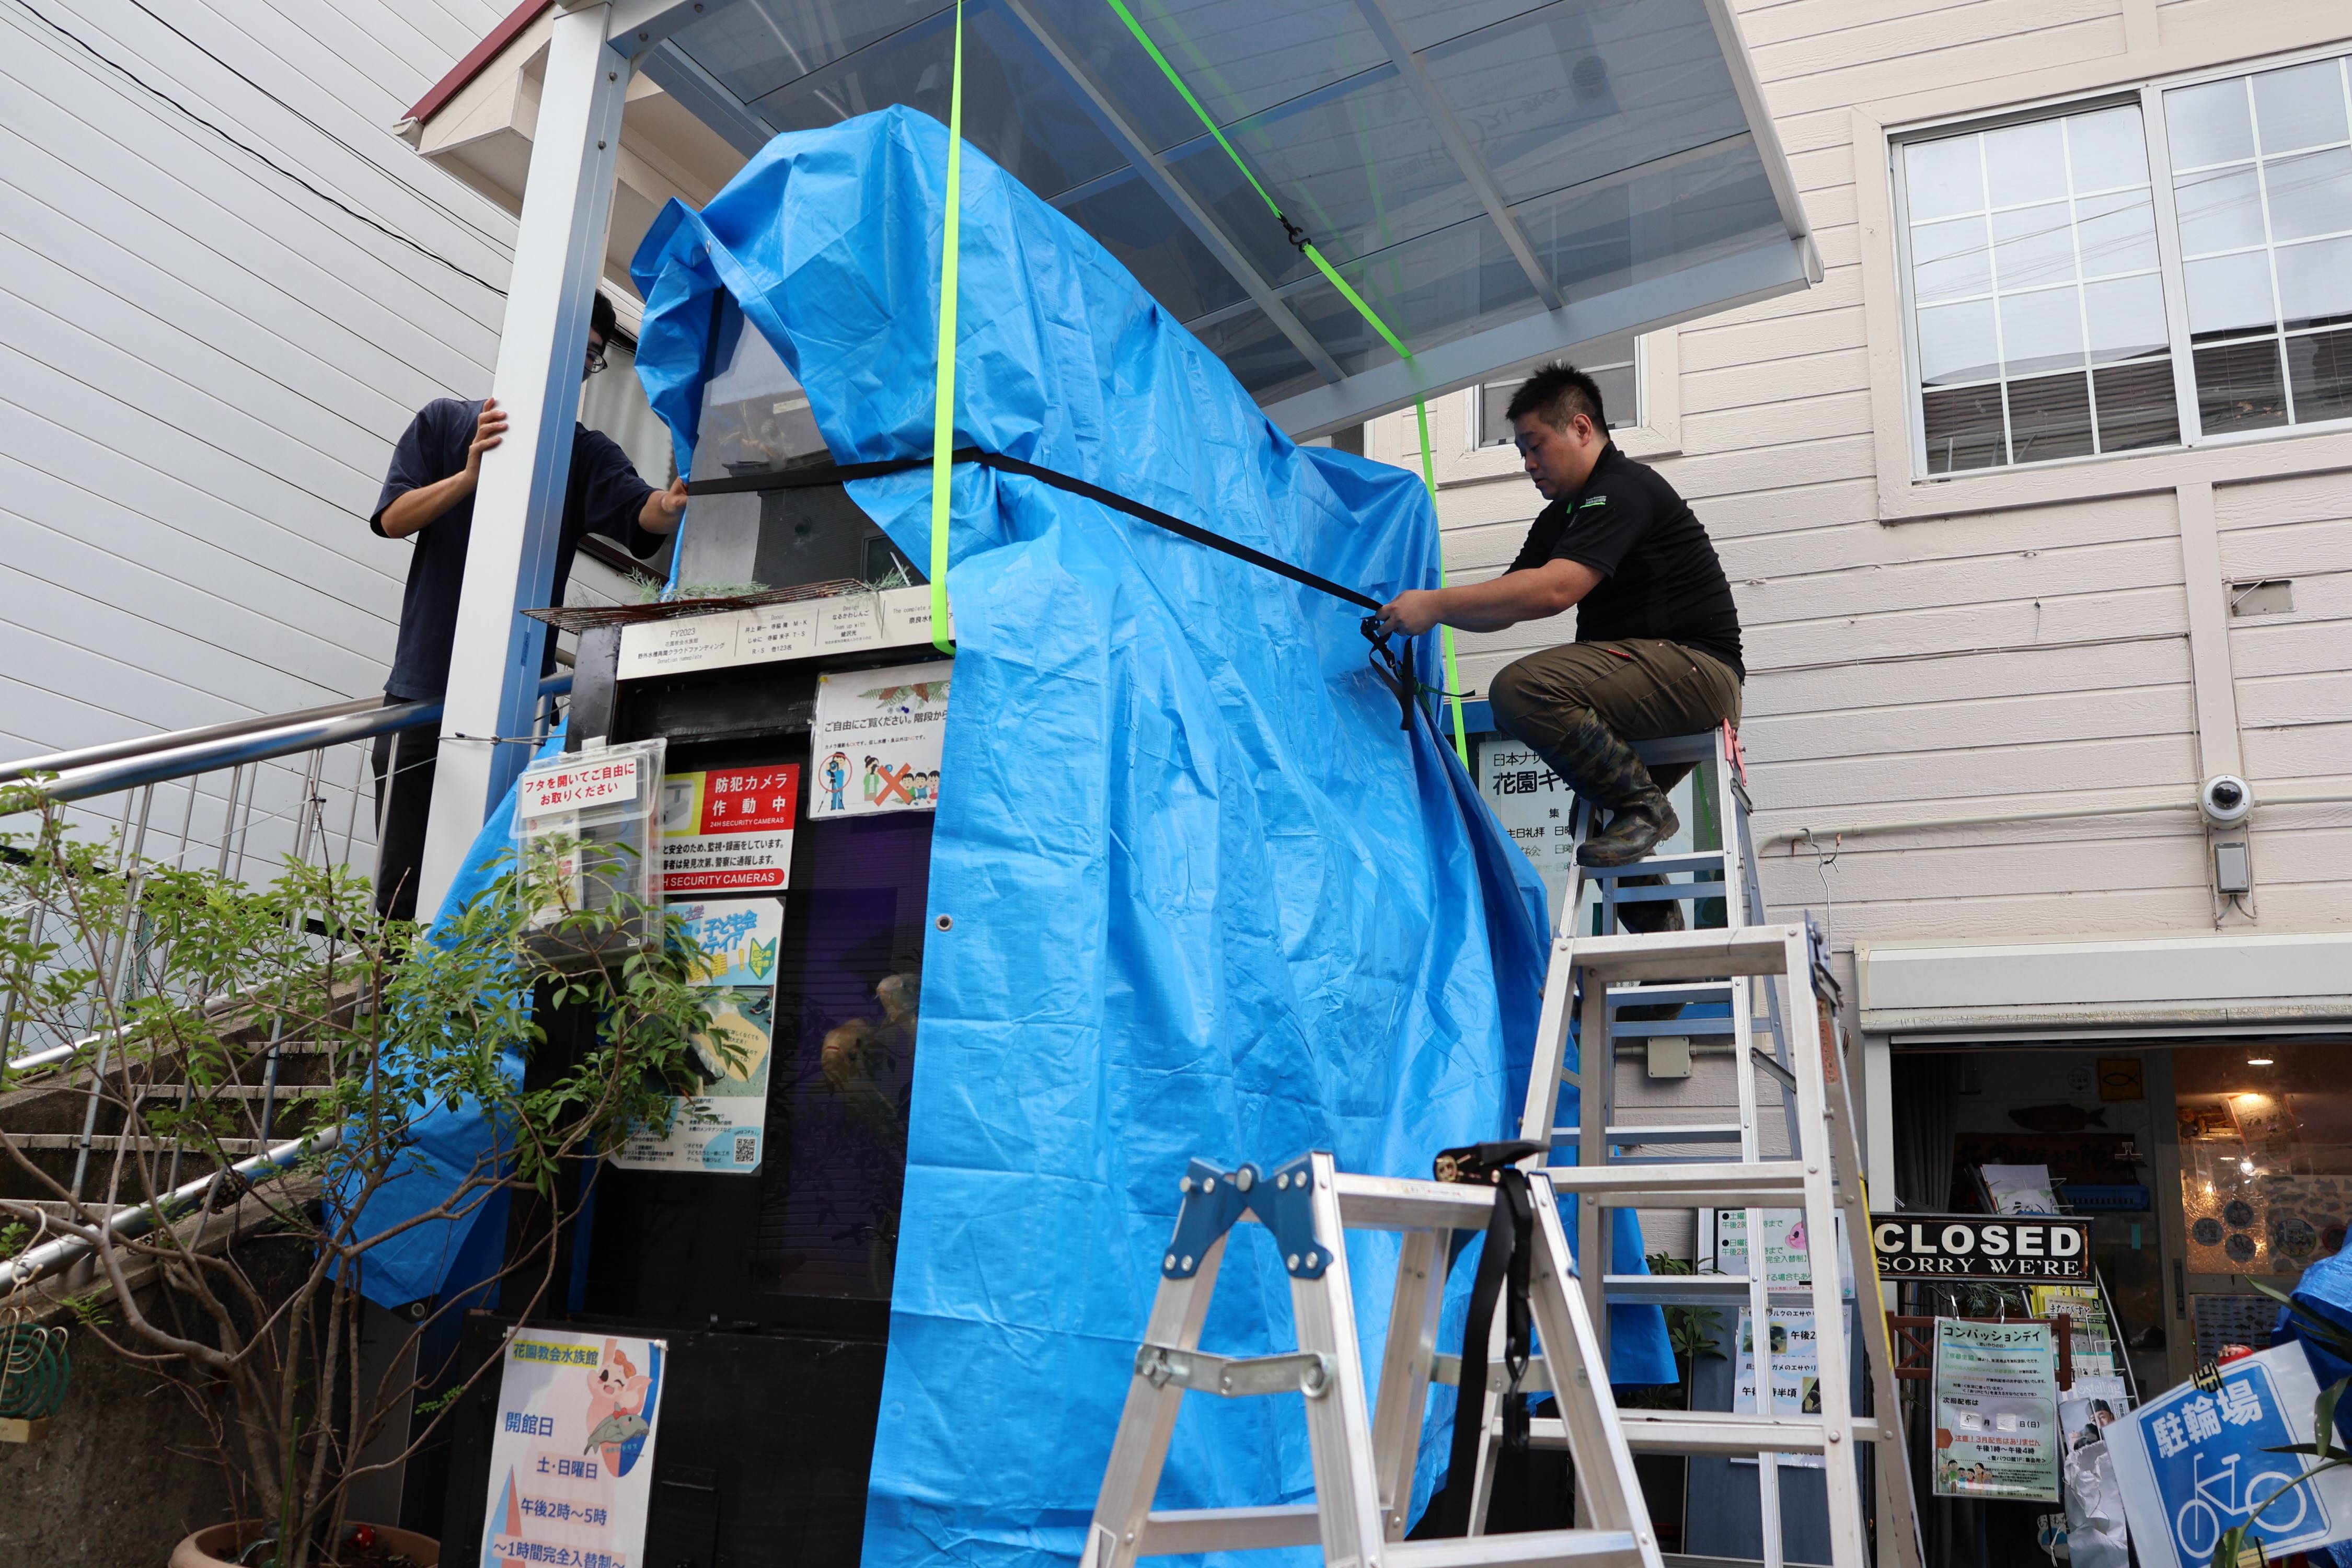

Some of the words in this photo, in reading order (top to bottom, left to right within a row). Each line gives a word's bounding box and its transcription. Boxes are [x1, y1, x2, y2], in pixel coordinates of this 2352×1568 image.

[670, 628, 696, 637] FY2023
[525, 763, 635, 793] フタを開いてご自由に
[714, 773, 788, 793] 防犯カメラ
[1493, 769, 1573, 795] 花園キ
[540, 782, 618, 806] お取りください
[753, 817, 785, 825] CAMERAS
[1507, 826, 1546, 839] 主日礼拝
[671, 875, 722, 887] SECURITY
[723, 872, 775, 884] CAMERAS
[1874, 1223, 2081, 1256] CLOSED
[1877, 1256, 1976, 1273] SORRY
[1987, 1259, 2082, 1276] WE'RE
[513, 1342, 600, 1367] 花園教会水族館
[1942, 1397, 1979, 1406] 次回配布は
[505, 1412, 554, 1437] 開館日
[2152, 1378, 2264, 1459] 駐輪場
[536, 1456, 598, 1480] 土・日曜日
[521, 1497, 607, 1526] 午後2時～5時
